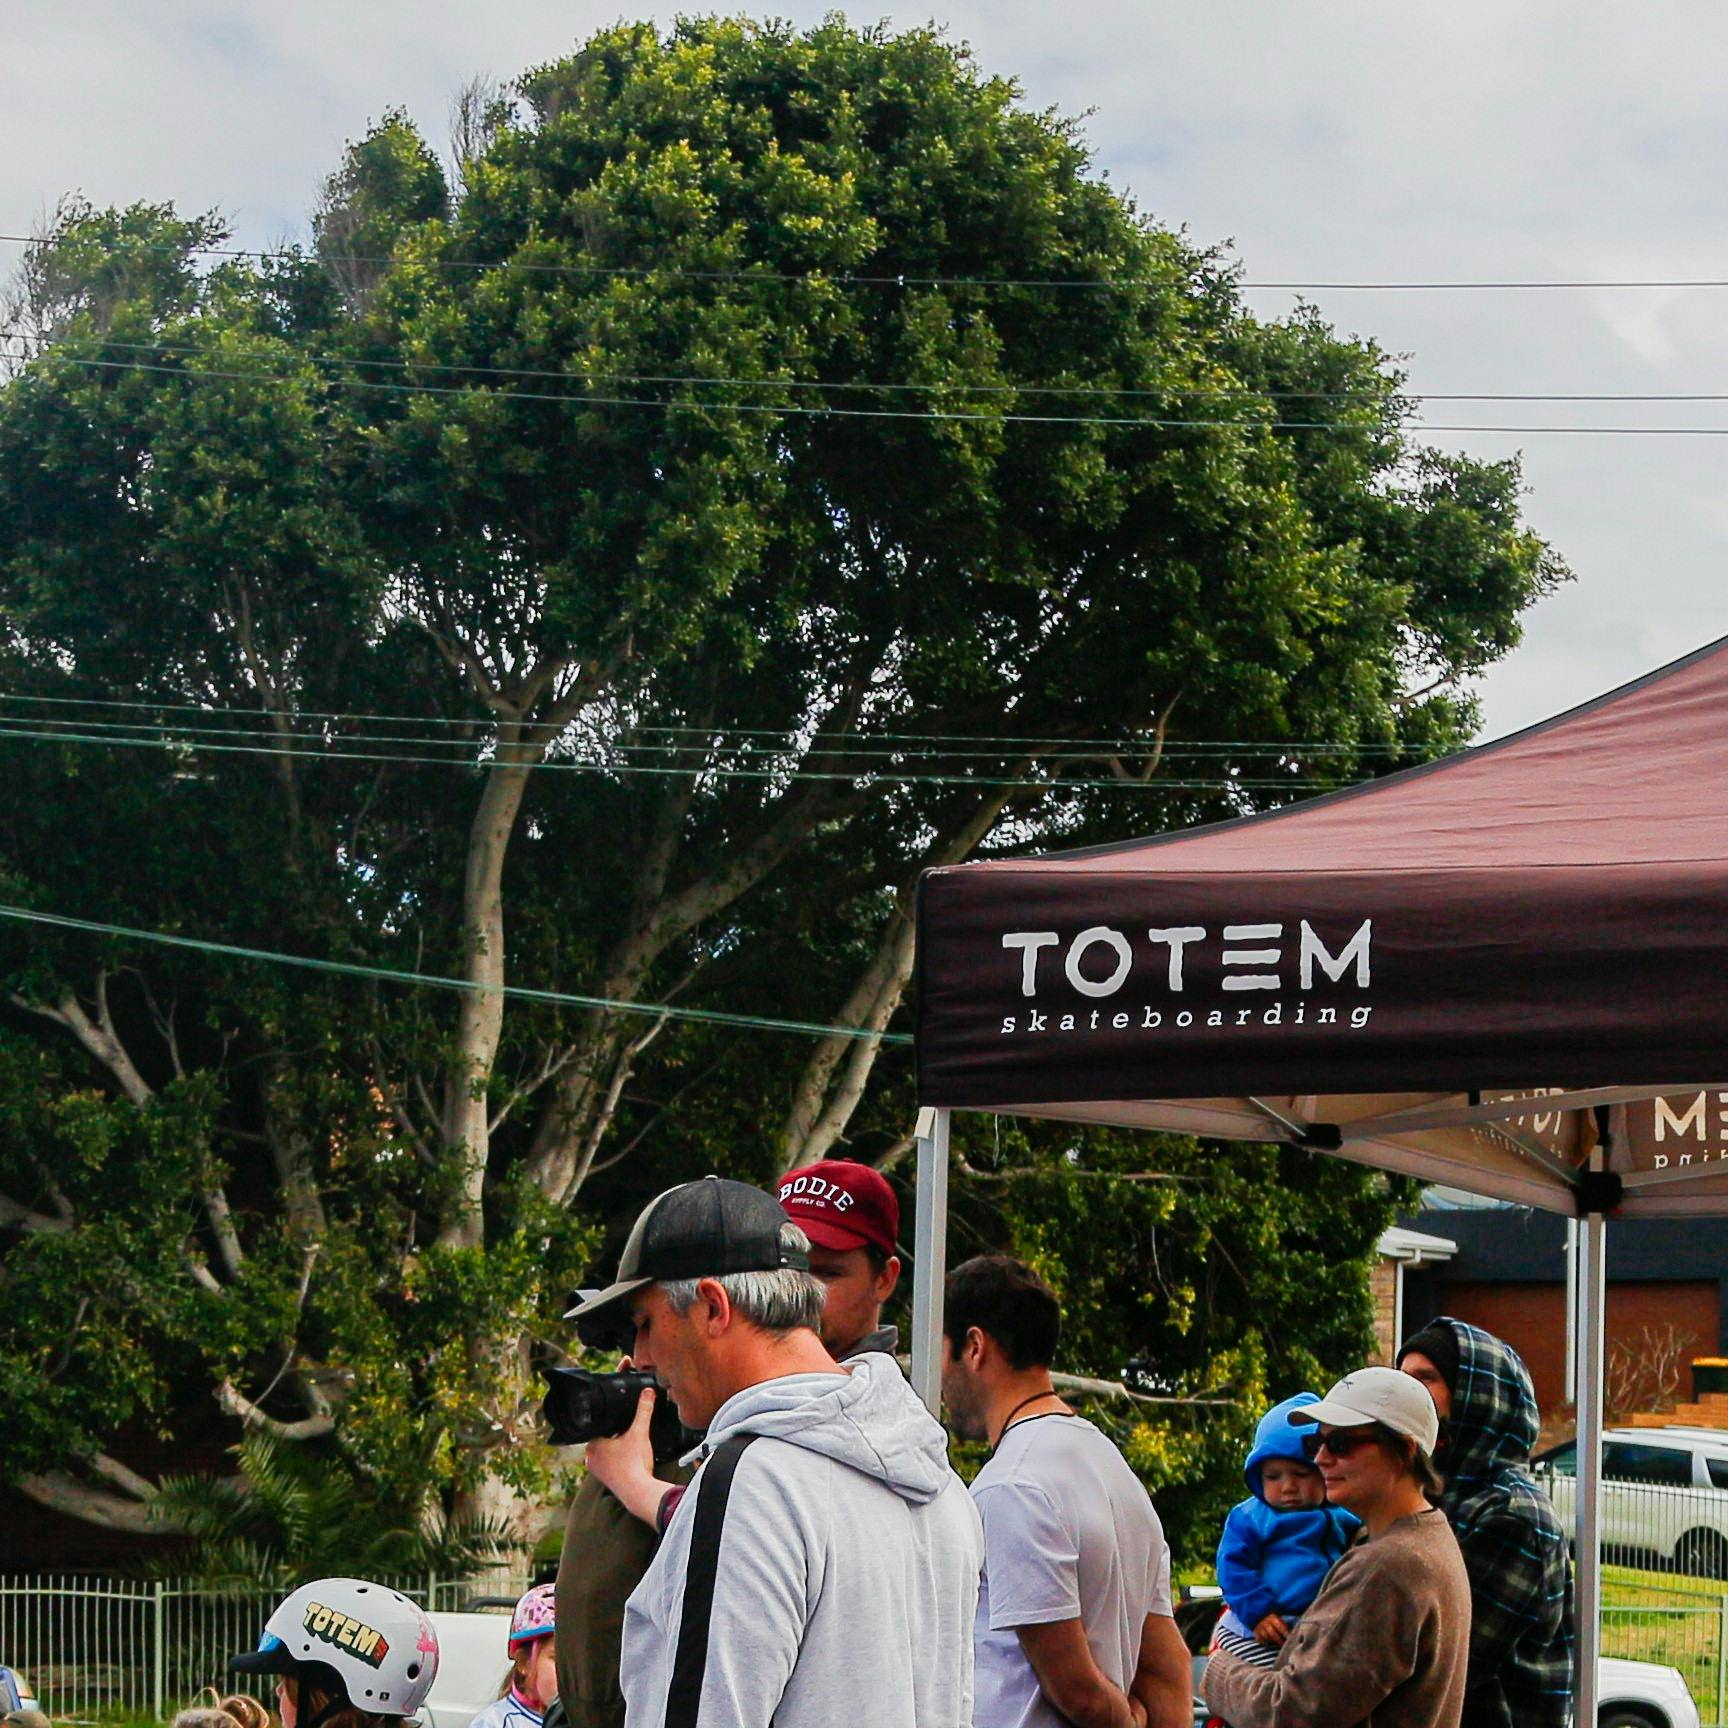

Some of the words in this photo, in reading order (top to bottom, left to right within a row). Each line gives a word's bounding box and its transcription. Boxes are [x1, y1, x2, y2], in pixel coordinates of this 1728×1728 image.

[1001, 918, 1373, 998] TOTEM
[1000, 1002, 1374, 1035] skateboarding
[778, 1176, 855, 1211] BODIE
[304, 1602, 385, 1660] TOTEM
